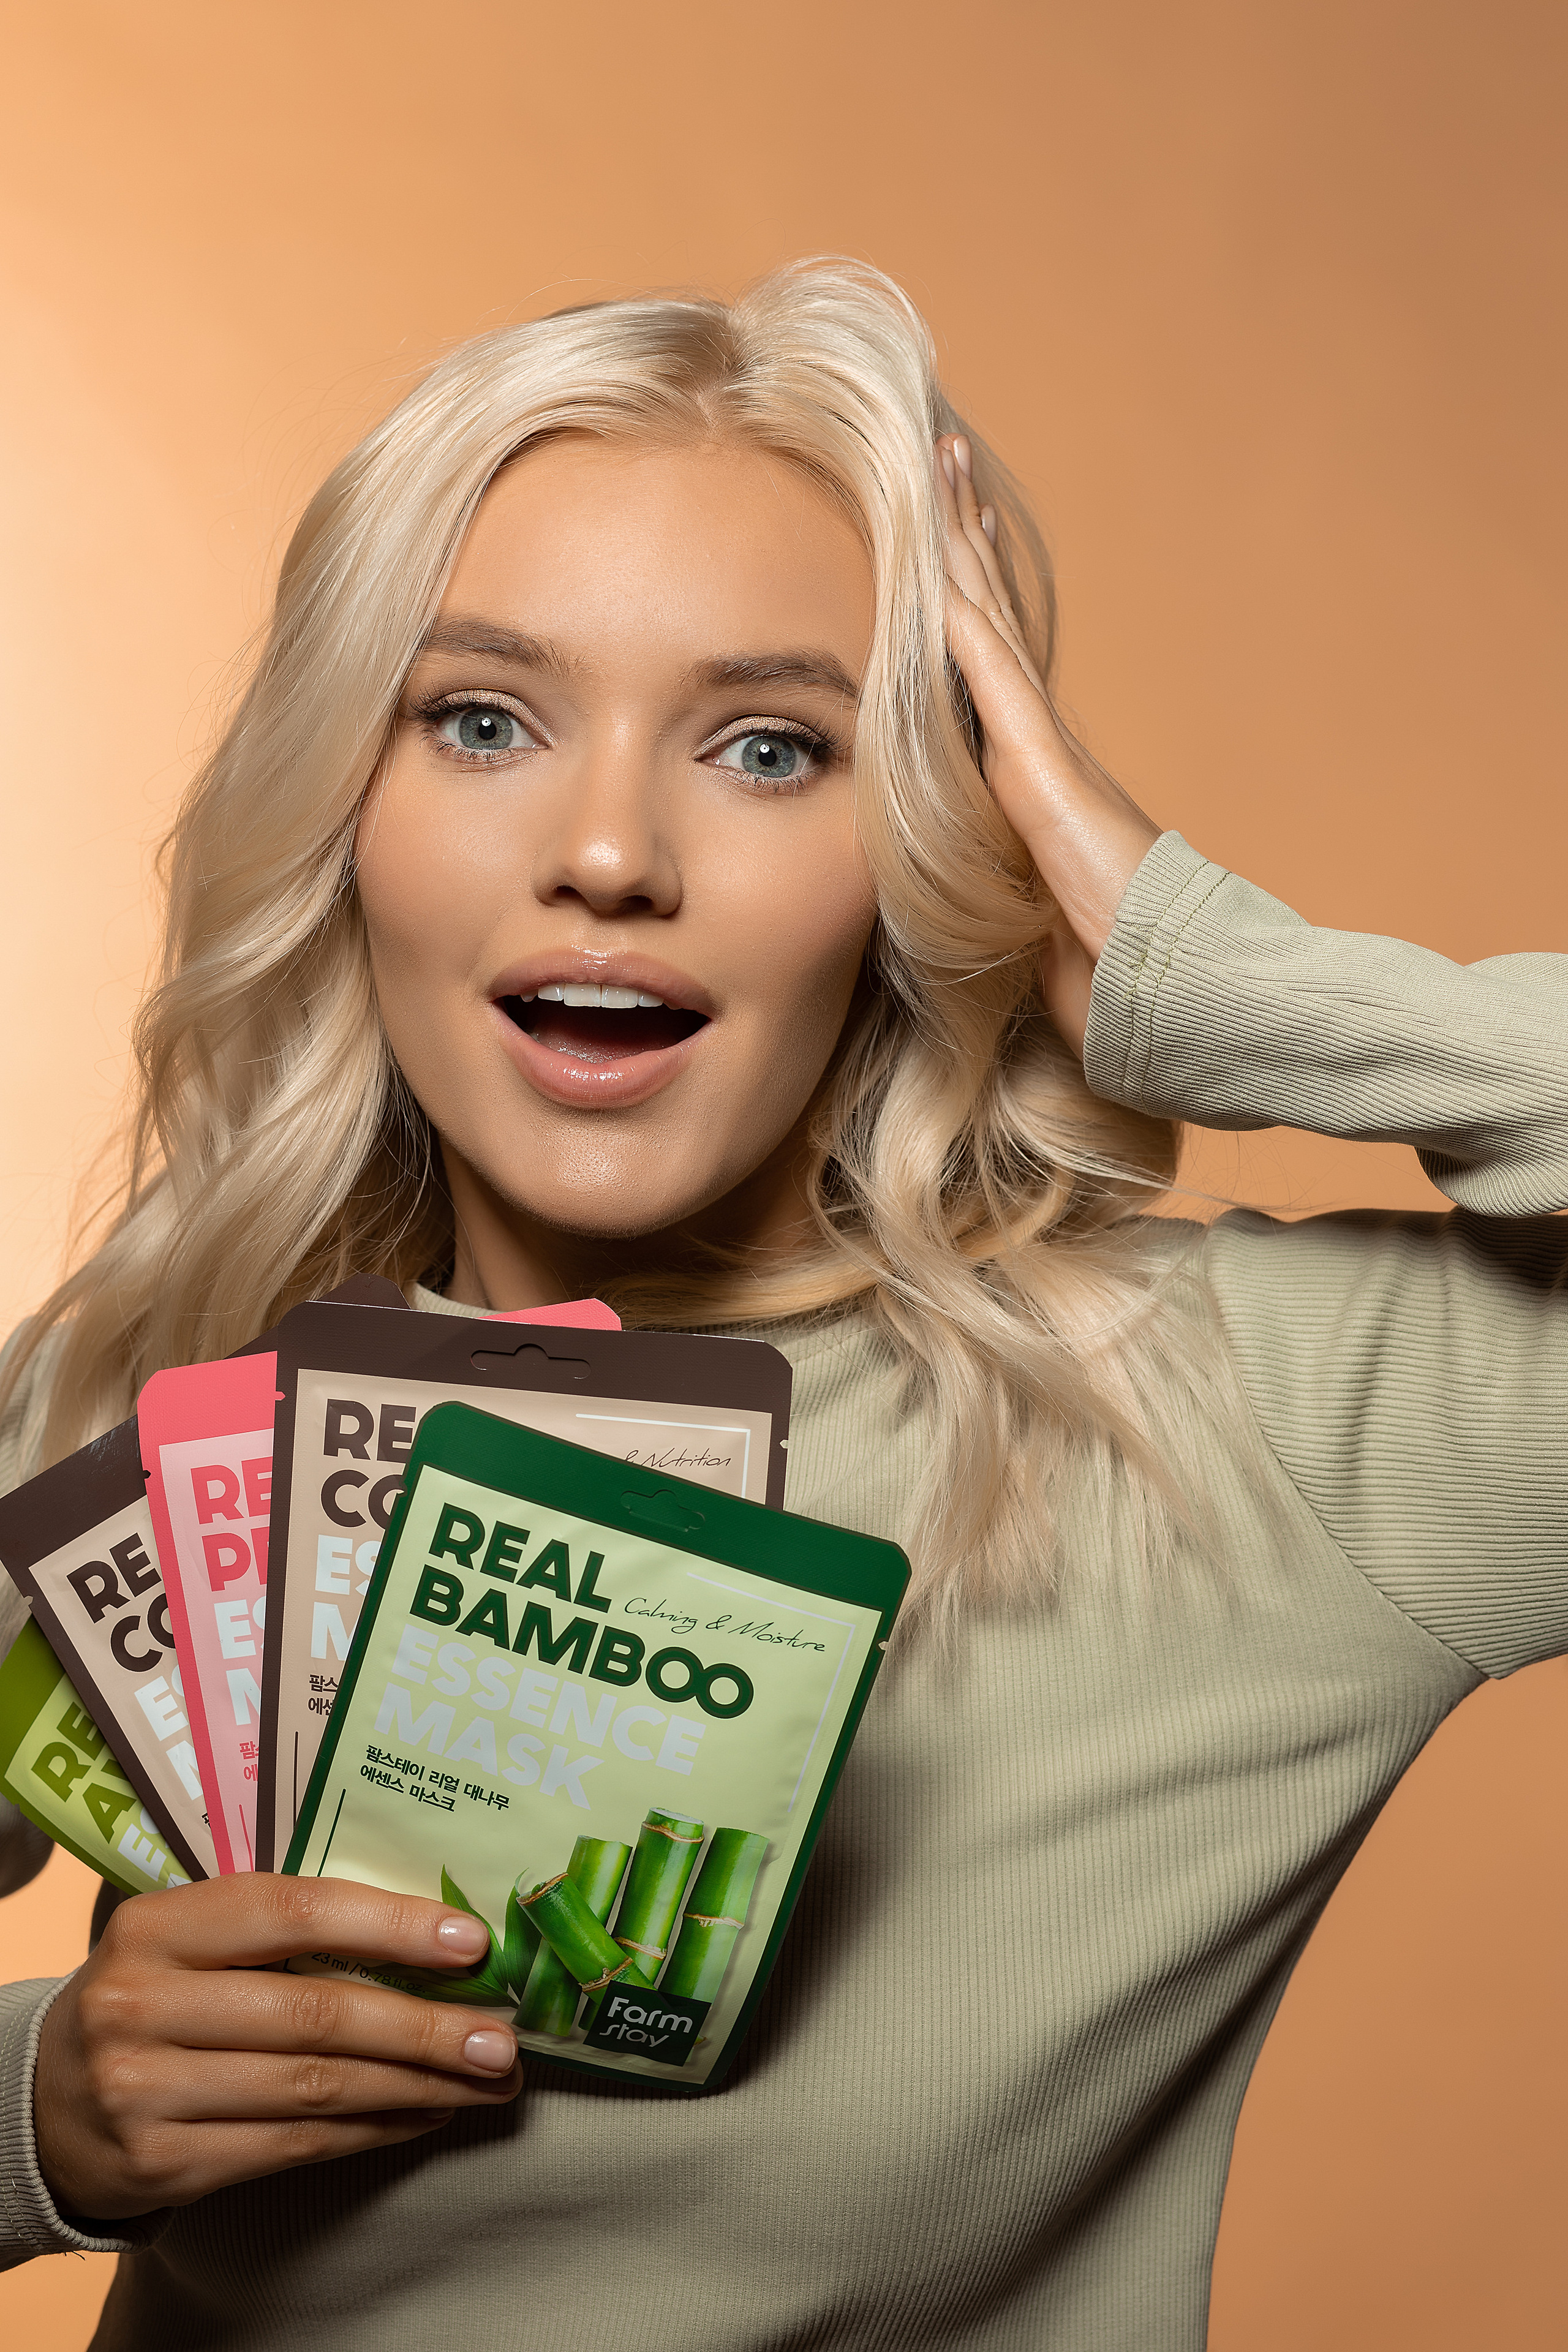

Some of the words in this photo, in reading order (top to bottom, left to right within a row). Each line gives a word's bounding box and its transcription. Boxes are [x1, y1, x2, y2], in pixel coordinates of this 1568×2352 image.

[323, 1398, 417, 1464] RE
[641, 1447, 731, 1468] Nutrition
[66, 1532, 162, 1624] RE
[428, 1502, 612, 1614] REAL
[409, 1563, 755, 1719] BAMBOO
[706, 1615, 732, 1630] &
[728, 1621, 825, 1652] Moisture
[391, 1623, 707, 1777] ESSENCE
[366, 1744, 426, 1781] 팜스테이
[428, 1770, 461, 1794] 리얼
[463, 1782, 510, 1811] 대나무
[373, 1681, 605, 1811] MASK
[360, 1764, 405, 1794] 에센스
[409, 1784, 456, 1813] 마스크
[359, 1967, 391, 1985] 0.78
[598, 2023, 670, 2048] stay
[607, 1996, 693, 2034] Farm
